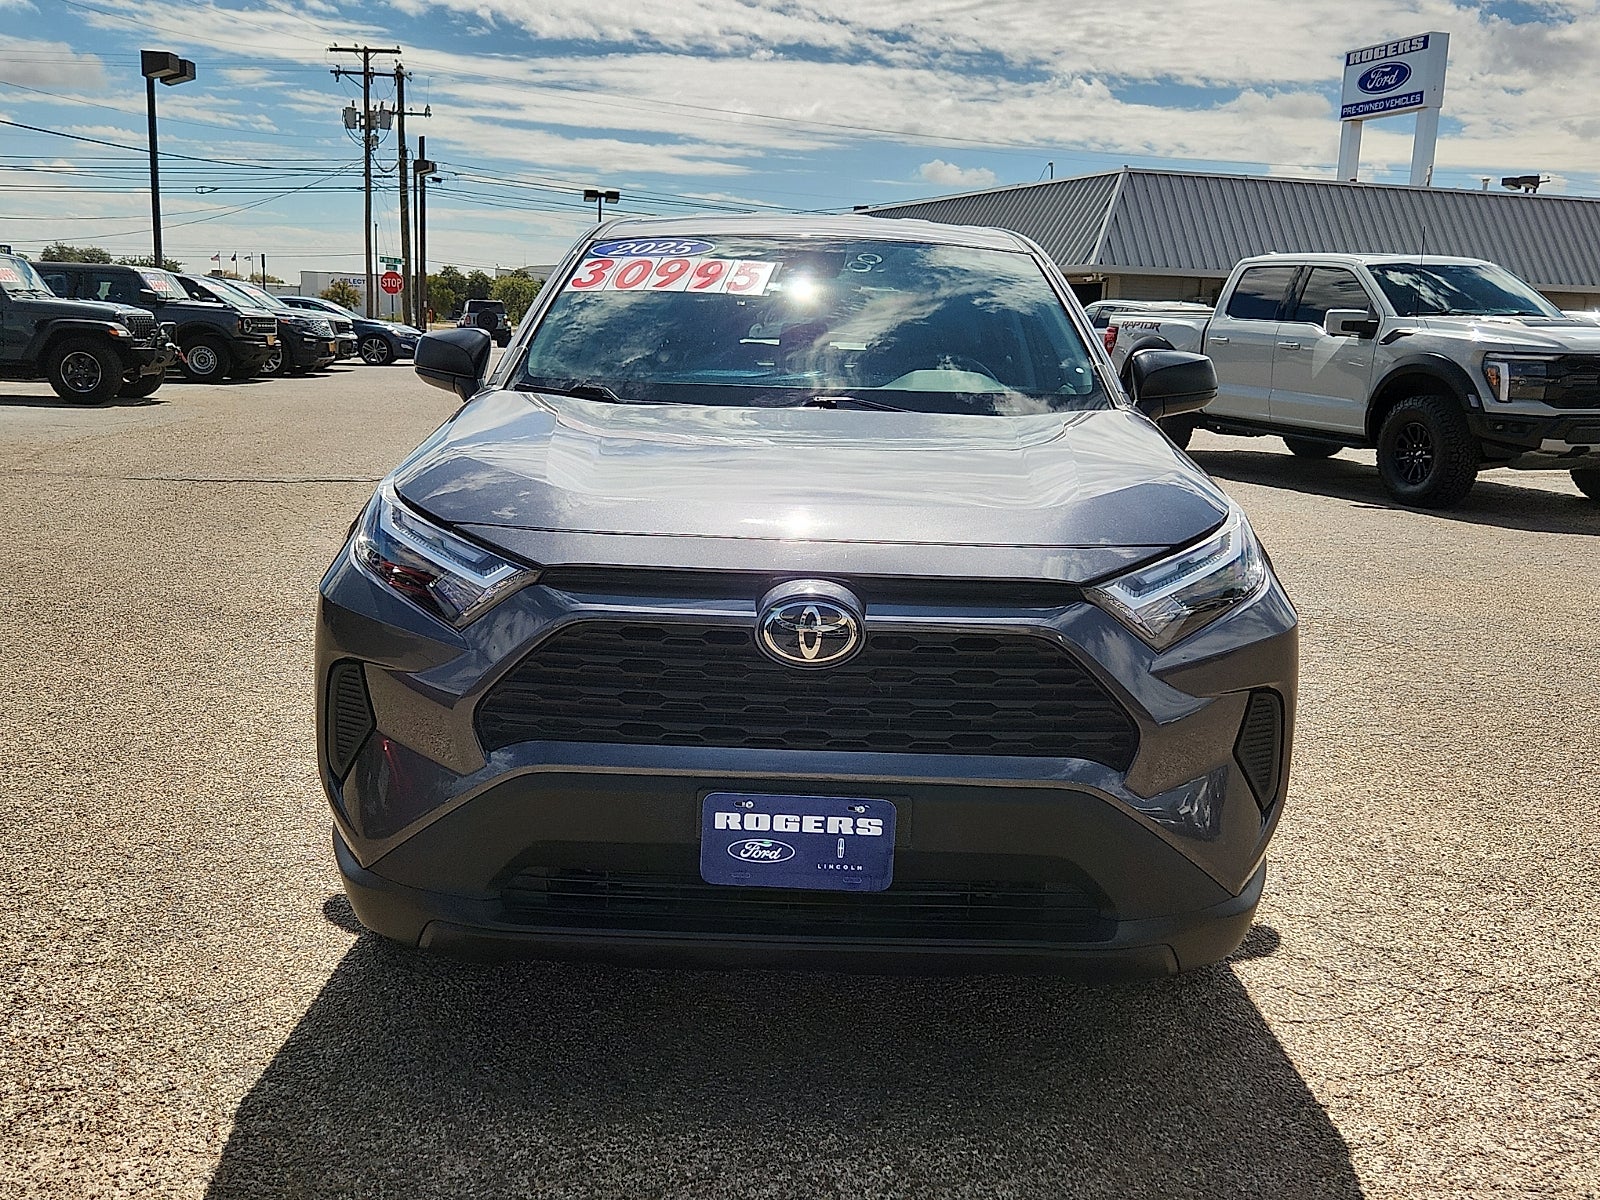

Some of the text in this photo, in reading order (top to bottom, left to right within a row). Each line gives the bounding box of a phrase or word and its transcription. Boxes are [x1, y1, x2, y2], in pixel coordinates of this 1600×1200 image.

[1348, 36, 1425, 65] ROGERS
[1366, 66, 1399, 89] Ford
[1342, 93, 1421, 116] PRE-OWNED VEHICLES
[609, 241, 699, 255] 2025
[381, 278, 402, 288] STOP
[571, 258, 768, 292] 30995
[1121, 320, 1162, 333] RAPTOR
[714, 812, 883, 836] ROGERS
[740, 841, 782, 860] Ford
[817, 863, 863, 871] LINCOLN
